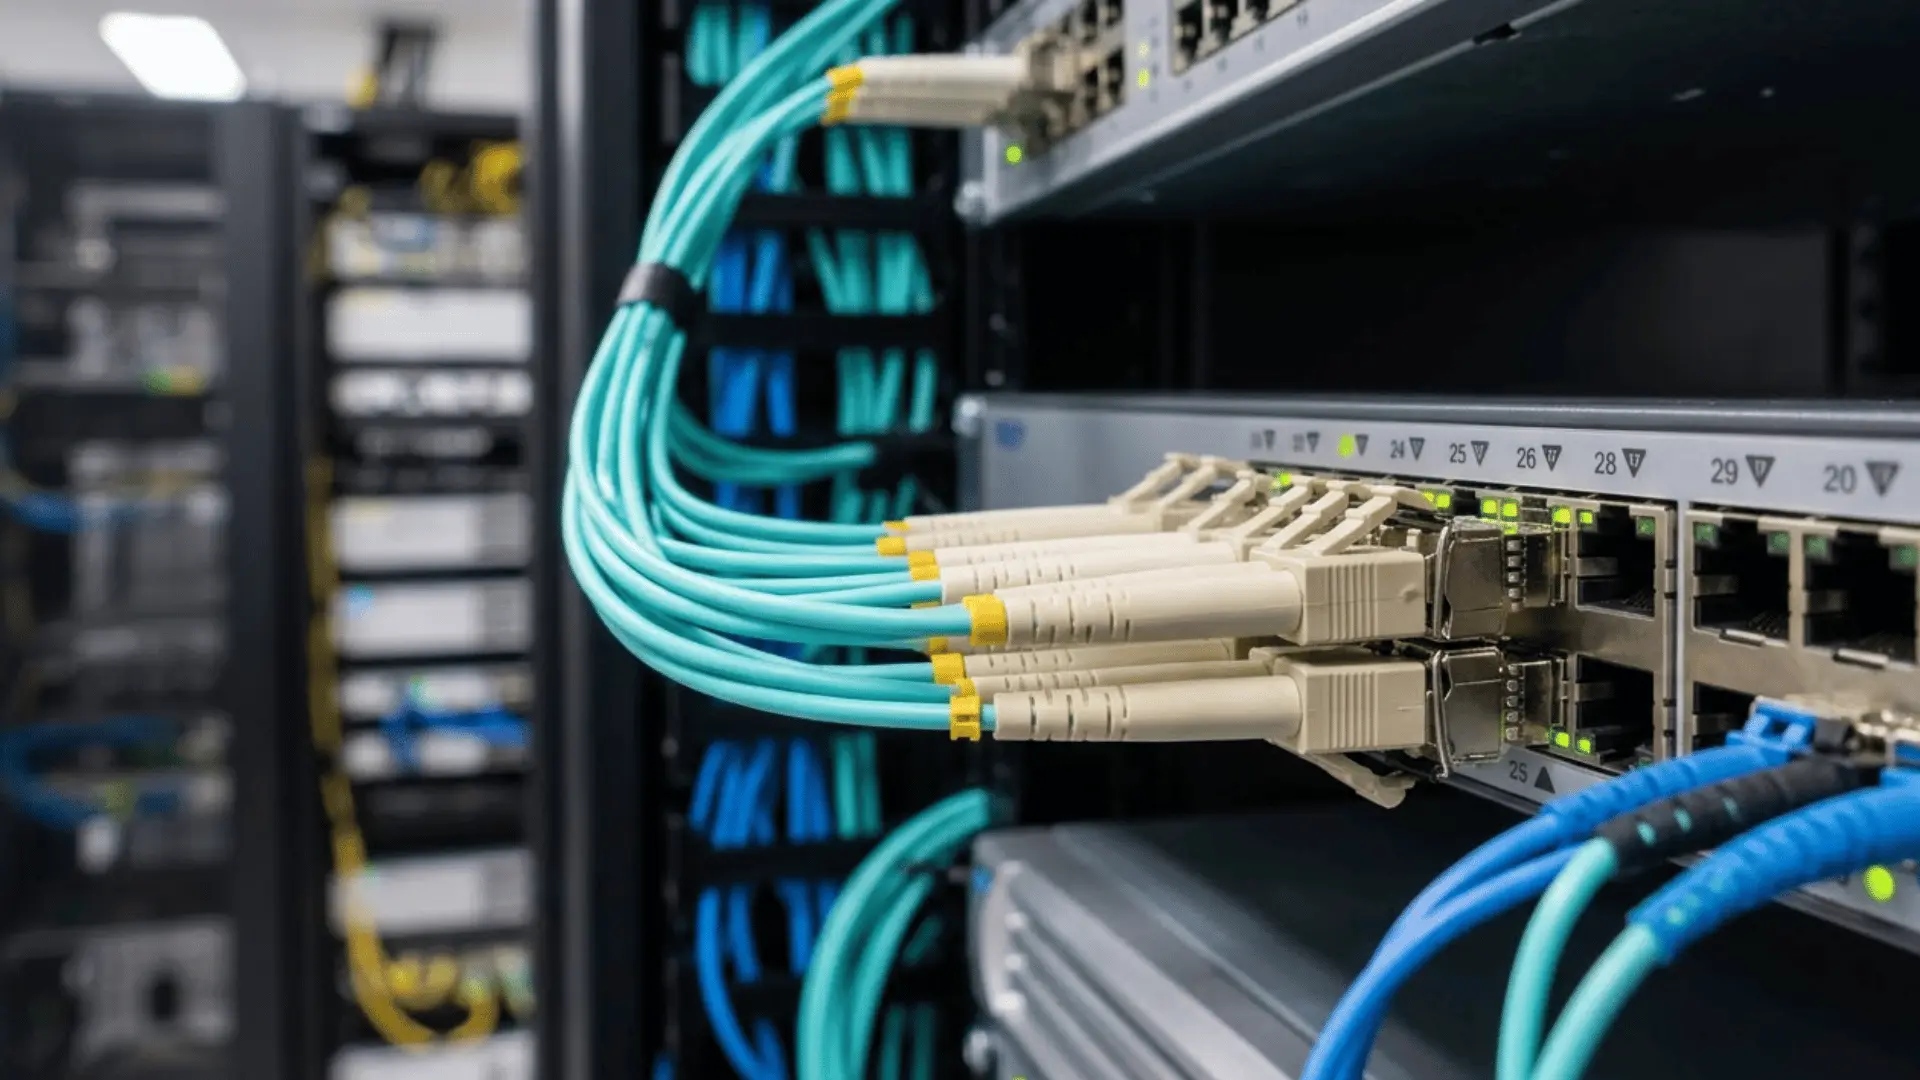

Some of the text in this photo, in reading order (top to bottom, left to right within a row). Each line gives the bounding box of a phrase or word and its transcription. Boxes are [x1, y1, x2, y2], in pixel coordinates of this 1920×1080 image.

[1449, 443, 1466, 464] 25
[1516, 447, 1536, 469] 26
[1594, 451, 1617, 475] 28
[1710, 457, 1738, 485] 29
[1823, 464, 1857, 494] 20
